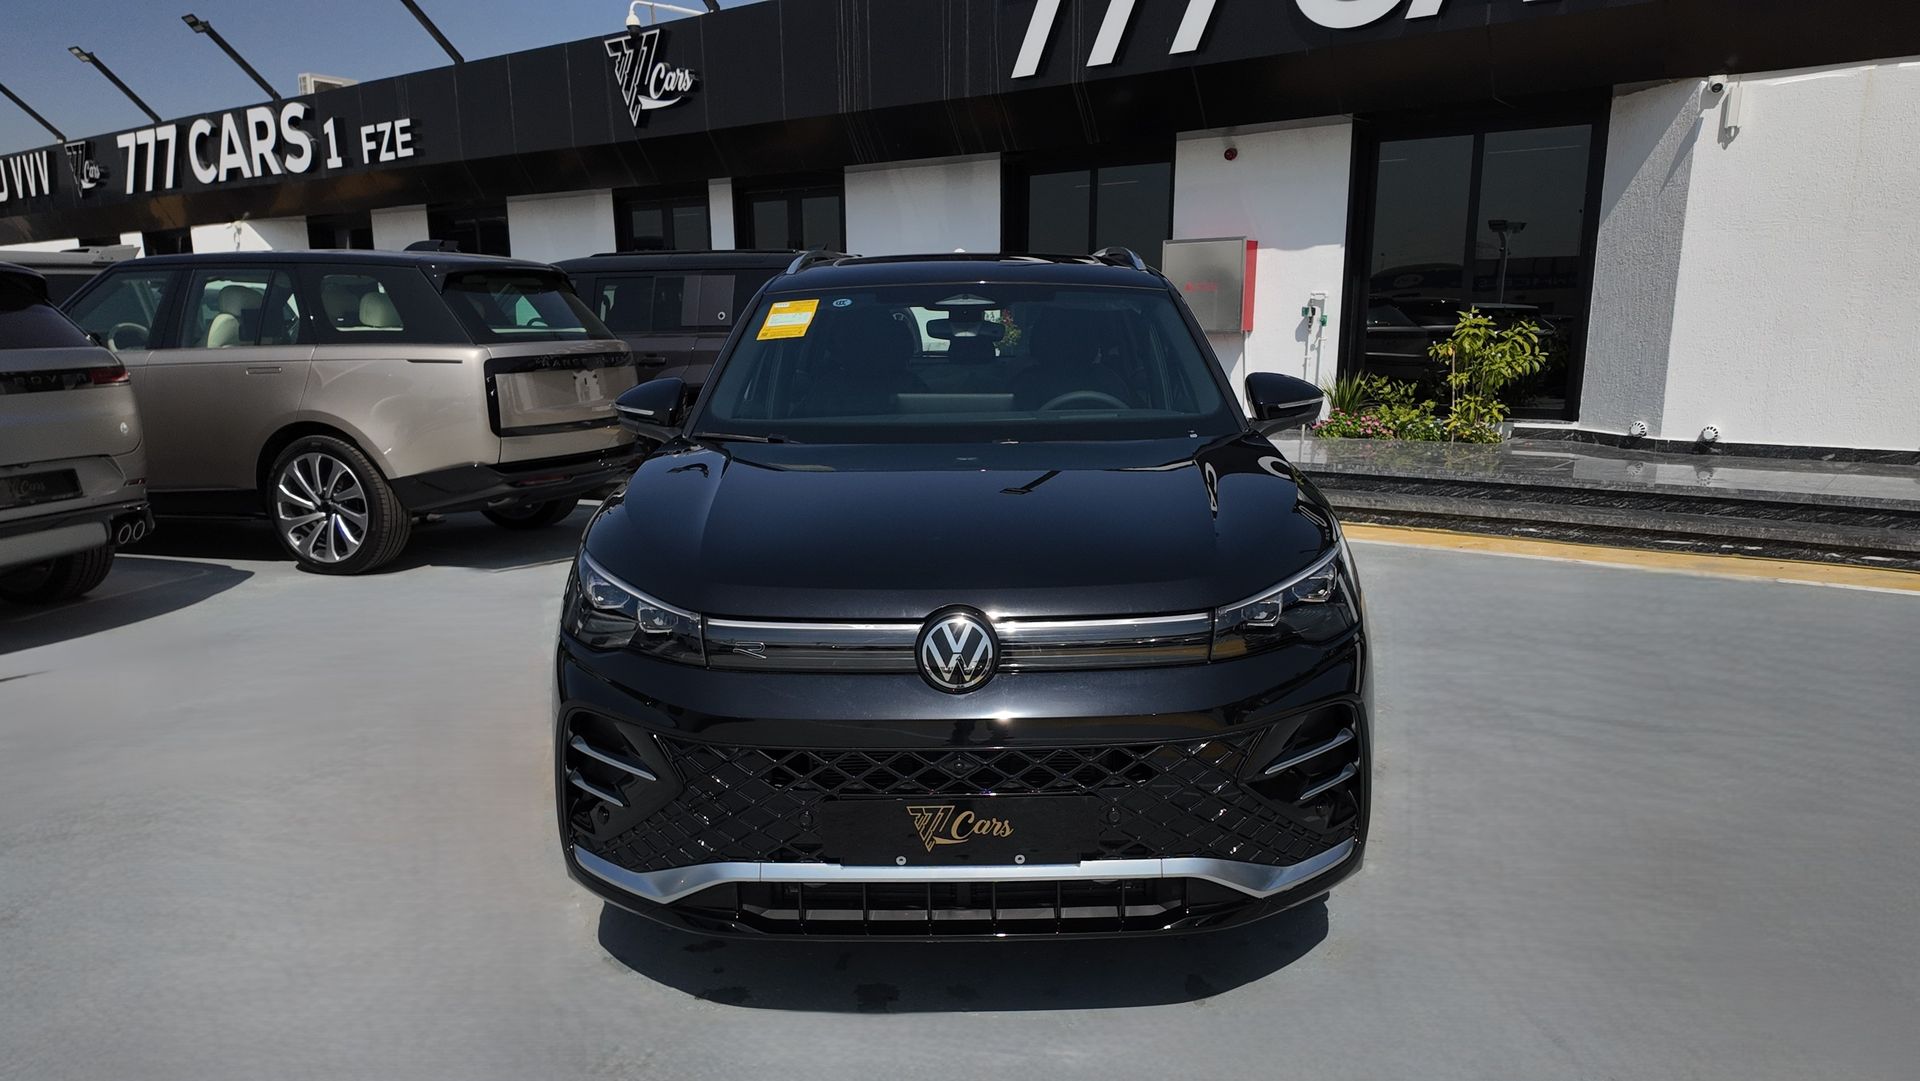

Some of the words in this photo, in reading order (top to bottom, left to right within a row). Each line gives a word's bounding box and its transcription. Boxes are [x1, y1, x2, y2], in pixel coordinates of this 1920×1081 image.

[649, 62, 693, 99] Cars
[116, 124, 177, 194] 777
[188, 102, 313, 184] CARS
[323, 117, 343, 169] 1
[360, 118, 414, 164] FZE
[951, 811, 1014, 838] Cars
